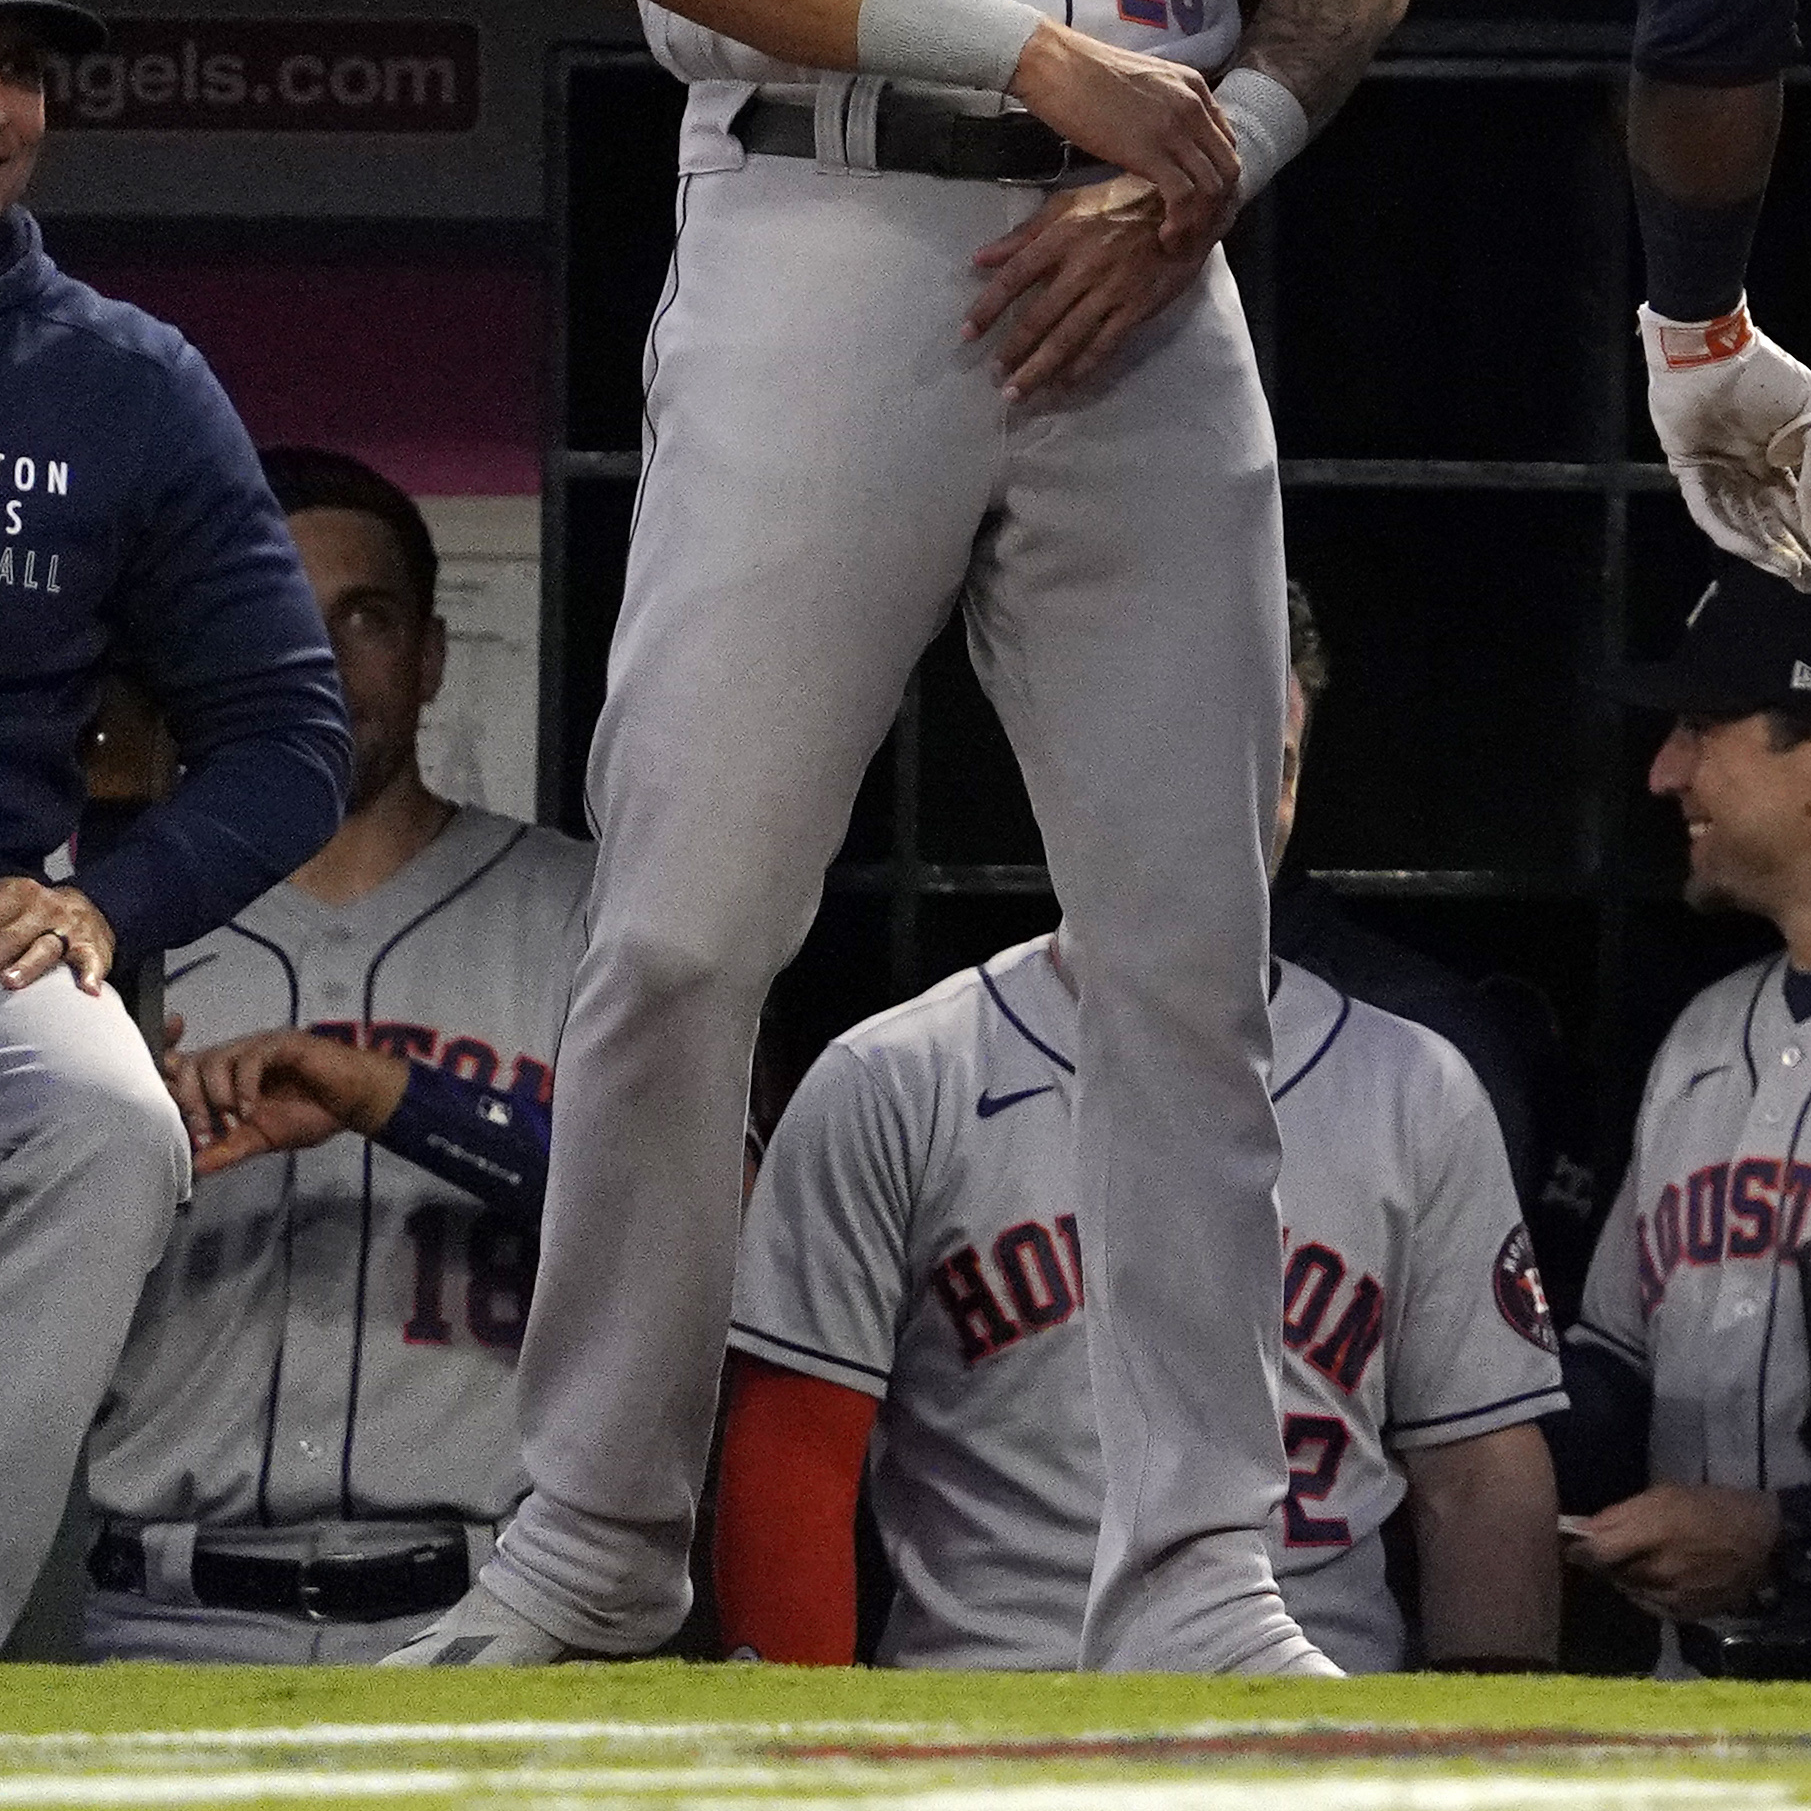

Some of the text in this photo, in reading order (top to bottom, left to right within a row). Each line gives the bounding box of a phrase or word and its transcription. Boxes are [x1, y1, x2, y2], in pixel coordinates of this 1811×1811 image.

[0, 453, 69, 496] ON
[5, 499, 23, 536] S
[0, 546, 62, 594] ALL
